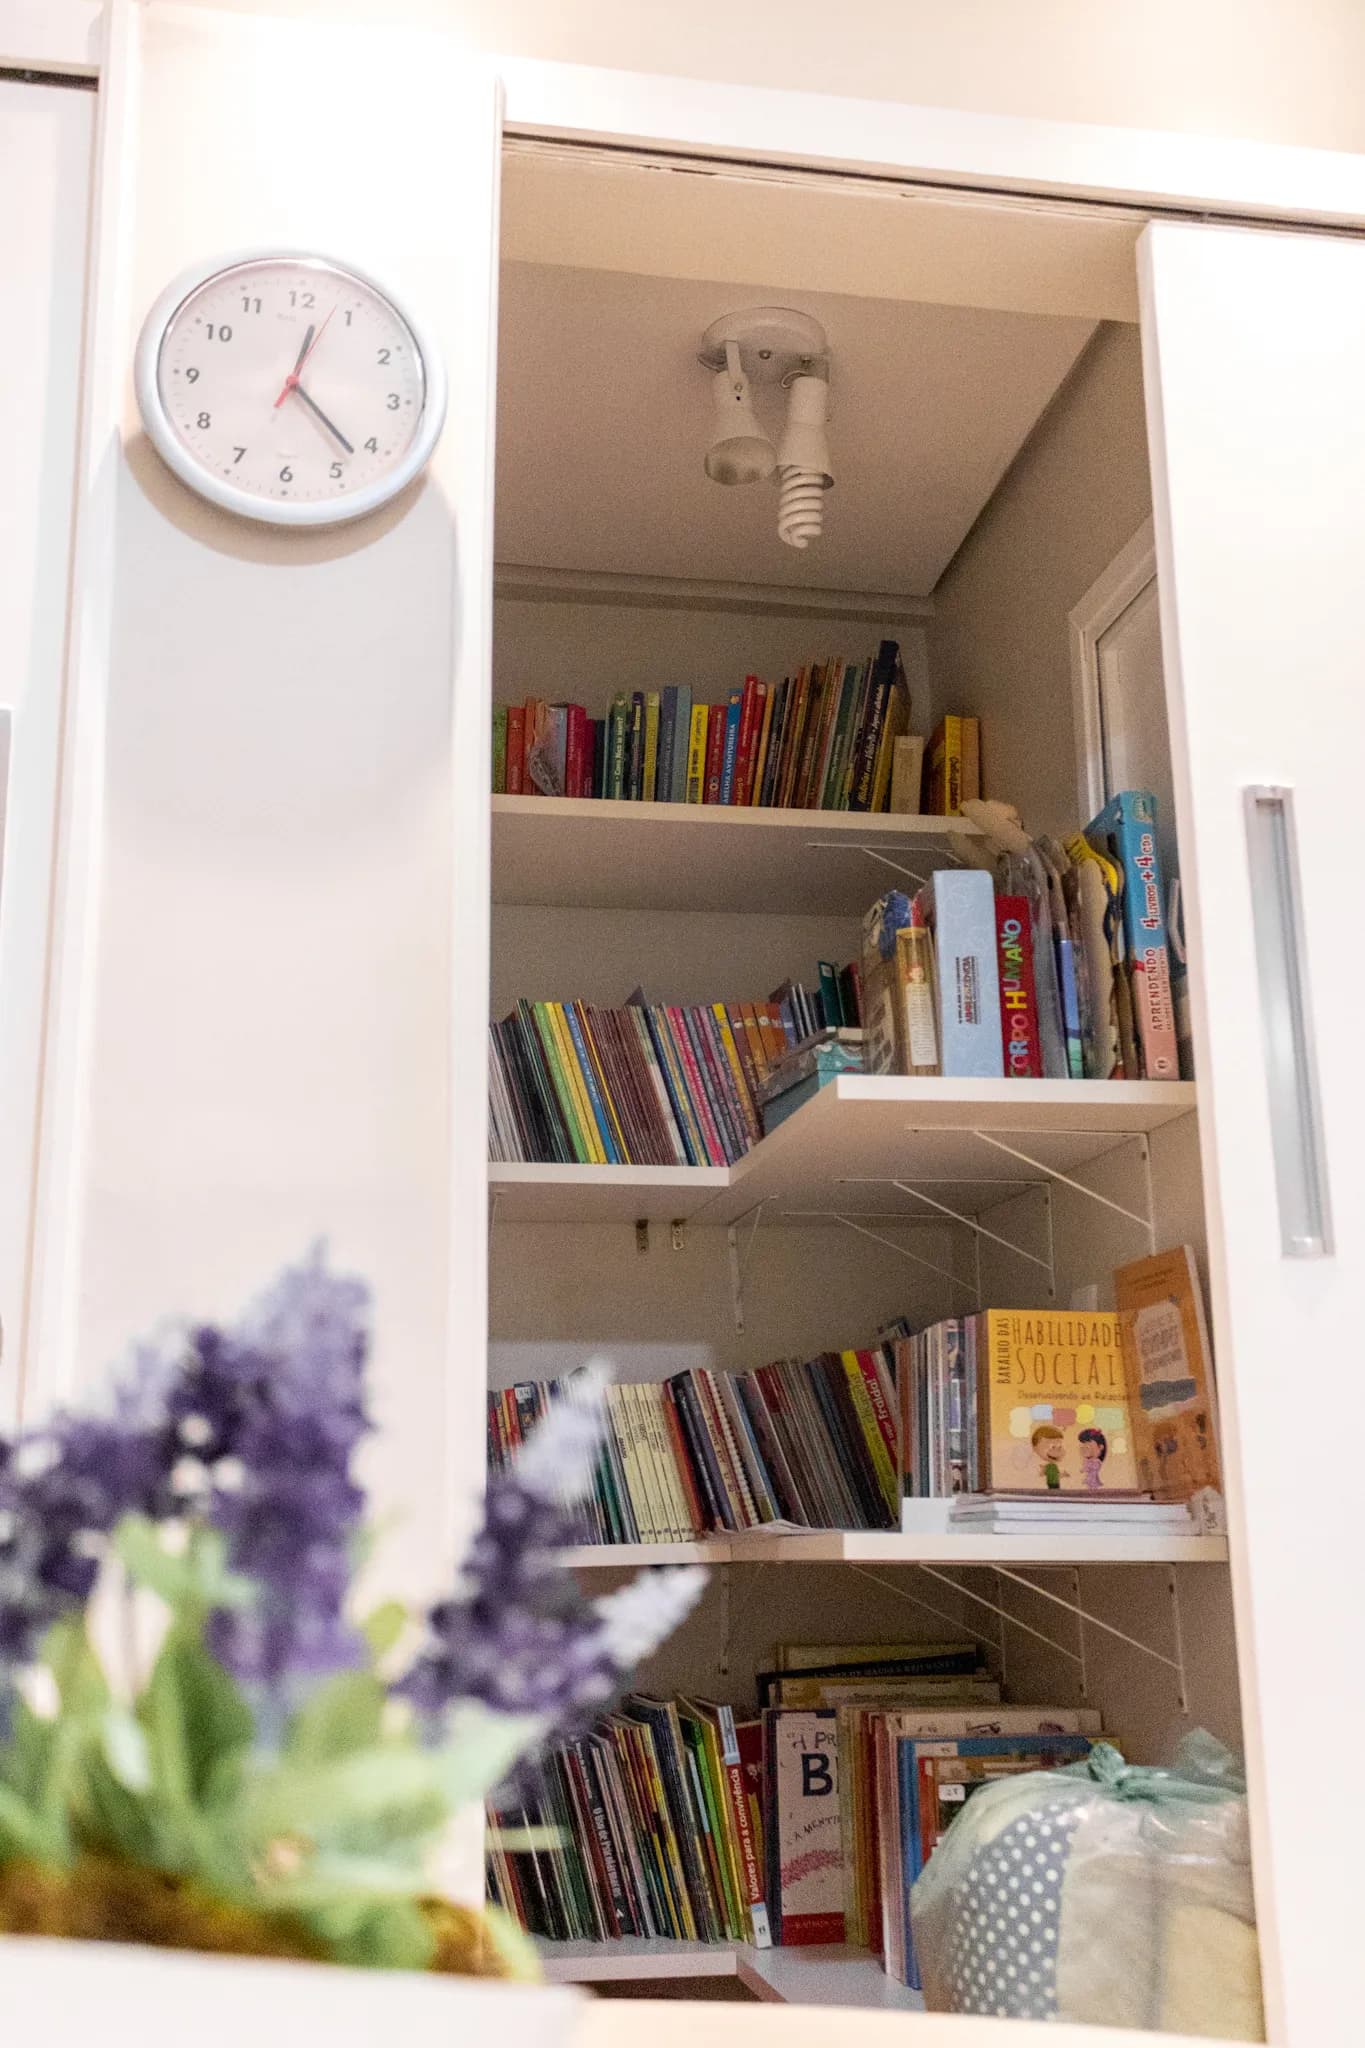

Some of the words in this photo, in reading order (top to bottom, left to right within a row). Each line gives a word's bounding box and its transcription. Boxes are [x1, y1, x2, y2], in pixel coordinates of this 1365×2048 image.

[241, 296, 263, 314] 11
[288, 290, 316, 310] 12
[344, 310, 353, 327] 1
[206, 323, 233, 343] 10
[377, 348, 391, 365] 2
[185, 367, 200, 385] 9
[386, 393, 401, 410] 3
[196, 411, 212, 430] 8
[363, 436, 379, 454] 4
[232, 446, 247, 464] 7
[279, 464, 294, 483] 6
[329, 461, 343, 480] 5
[723, 723, 736, 774] AVENTUREIRA
[1135, 856, 1155, 869] 4
[1145, 884, 1160, 917] LIVROS
[1139, 917, 1160, 930] 4
[1000, 919, 1028, 1009] HUMANO
[1144, 948, 1164, 1032] APRENDENDO
[1005, 1013, 1033, 1077] CORPO
[996, 1317, 1010, 1336] DAS
[1012, 1317, 1123, 1348] HABILIDADE
[996, 1339, 1011, 1384] BARALHO
[1015, 1348, 1121, 1386] SOCIAI
[814, 1731, 838, 1748] PR
[730, 1768, 748, 1825] convivência
[743, 1836, 756, 1863] para
[748, 1864, 763, 1899] Valores
